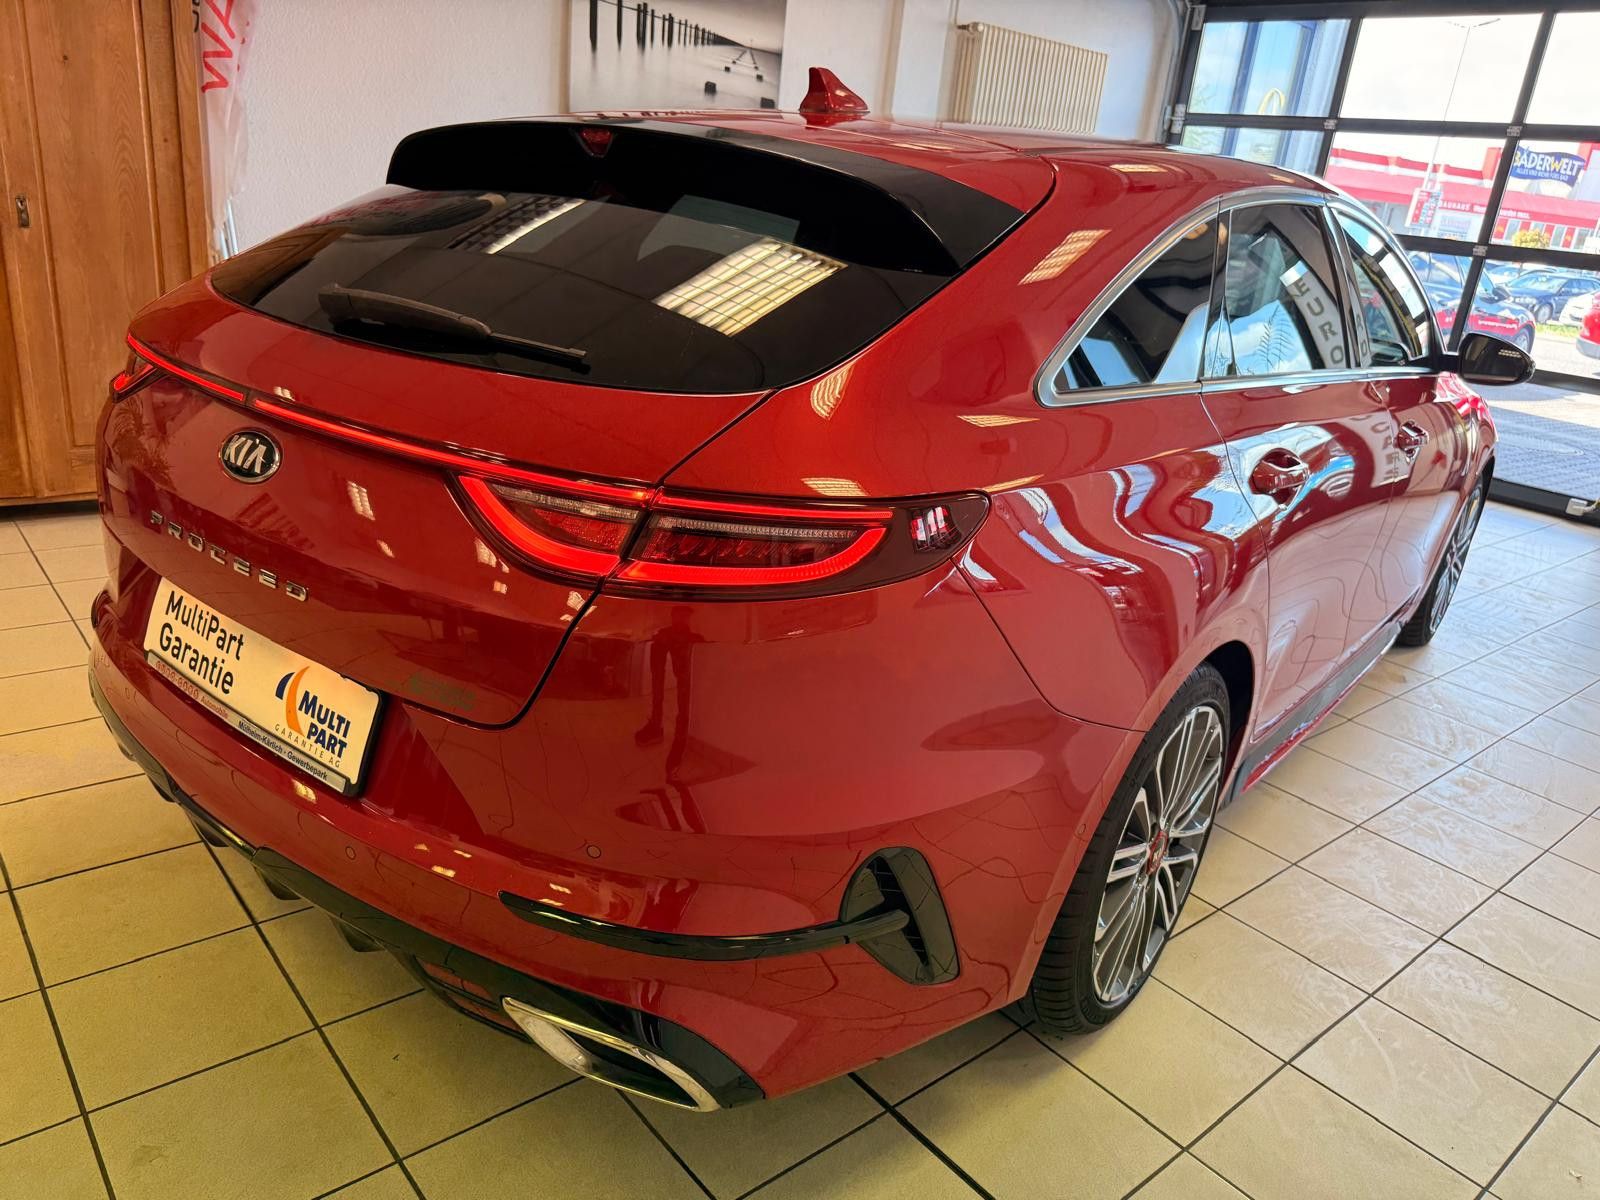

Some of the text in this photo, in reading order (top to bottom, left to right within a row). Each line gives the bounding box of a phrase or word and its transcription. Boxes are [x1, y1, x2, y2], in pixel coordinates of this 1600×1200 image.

[224, 435, 268, 473] KIA
[150, 510, 309, 602] PROCEED
[165, 591, 244, 661] MultiPart
[159, 623, 234, 695] Garantie
[298, 690, 351, 739] MULTI
[275, 724, 341, 768] GARANTIE AG
[307, 722, 347, 758] PART
